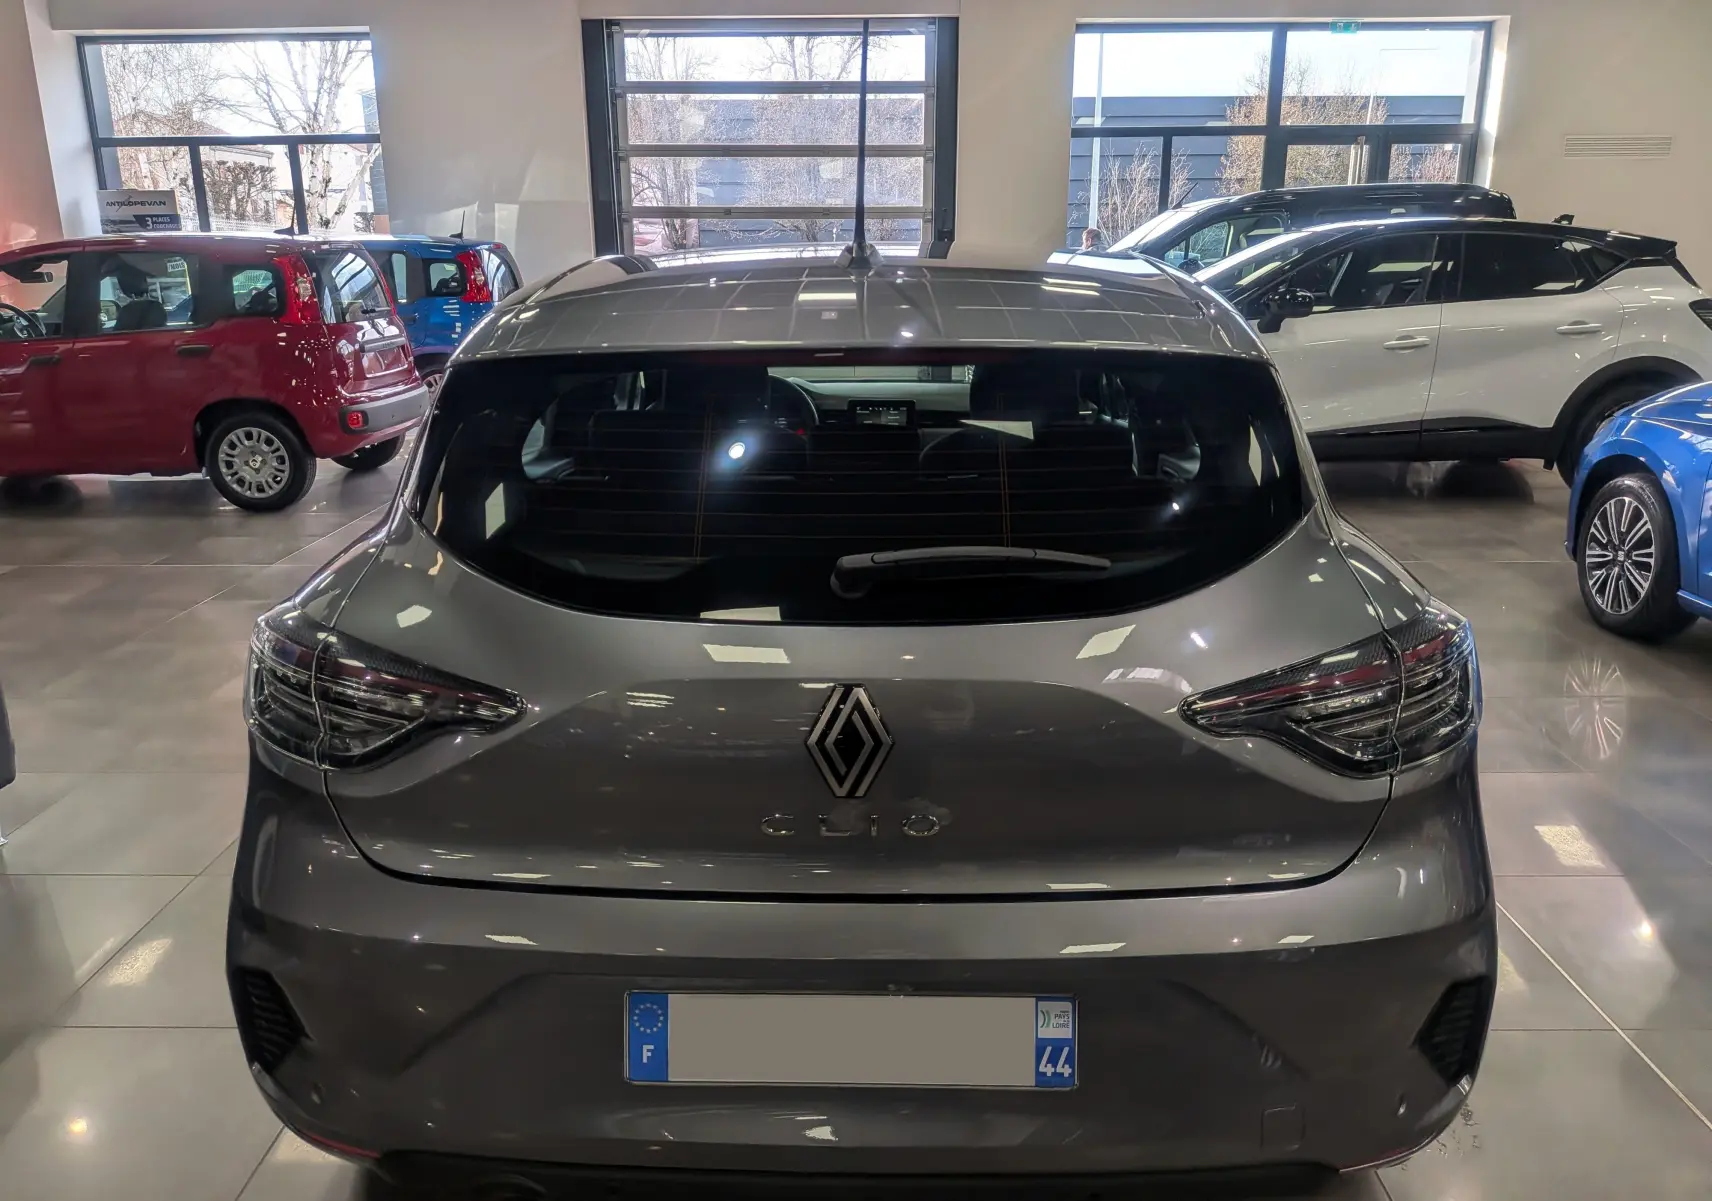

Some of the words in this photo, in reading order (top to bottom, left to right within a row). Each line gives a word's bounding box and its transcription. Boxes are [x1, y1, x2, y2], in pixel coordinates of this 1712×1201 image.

[145, 217, 153, 230] 3
[761, 813, 942, 837] CLIO
[642, 1044, 655, 1064] F
[1038, 1045, 1073, 1078] 44
